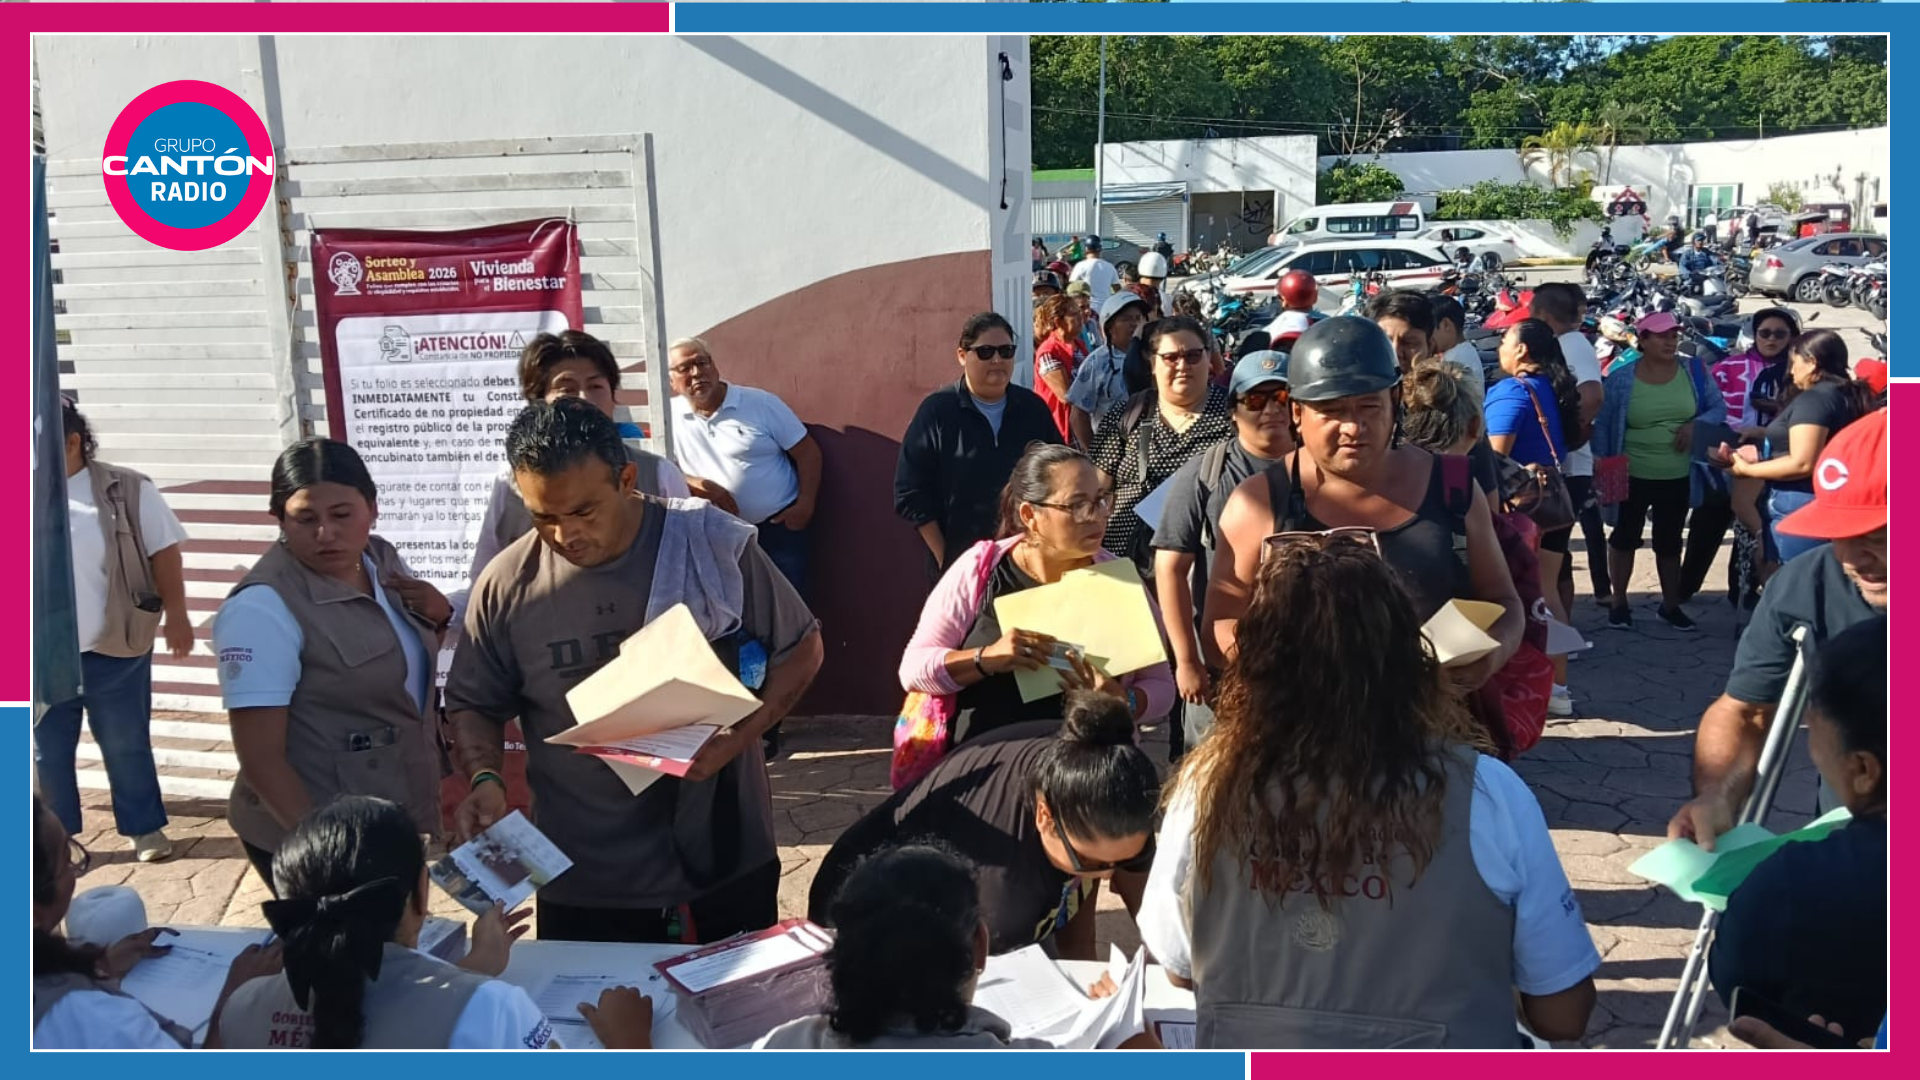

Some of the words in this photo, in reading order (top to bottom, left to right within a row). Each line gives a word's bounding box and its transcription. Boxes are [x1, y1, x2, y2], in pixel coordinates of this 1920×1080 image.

[365, 256, 407, 269] Sorteo
[409, 258, 416, 270] y
[470, 258, 535, 276] Vivienda
[366, 267, 425, 282] Asamblea
[428, 267, 457, 280] 2026
[493, 276, 567, 292] Bienestar
[414, 332, 506, 354] ¡ATENCIÓN!
[419, 352, 458, 361] Constancia
[470, 351, 483, 359] NO
[484, 350, 523, 359] PROPIEDA
[351, 379, 360, 389] Si
[362, 380, 373, 389] tu
[375, 378, 398, 389] folio
[400, 379, 412, 388] es
[414, 376, 480, 388] seleccionado
[483, 375, 515, 386] debes
[352, 391, 451, 404] INMEDIATAMENTE
[463, 393, 475, 402] tu
[487, 391, 525, 401] Consta
[354, 407, 412, 419] Certificado
[415, 408, 428, 418] de
[431, 410, 445, 418] no
[449, 406, 503, 419] propiedad
[356, 423, 364, 433] el
[368, 423, 410, 436] registro
[414, 420, 452, 434] público
[456, 421, 469, 432] de
[473, 421, 483, 431] la
[487, 422, 511, 435] prop
[357, 437, 420, 449] equivalente
[435, 438, 448, 447] en
[451, 438, 474, 446] caso
[478, 436, 491, 446] de
[427, 449, 471, 462] también
[474, 449, 482, 461] el
[485, 450, 498, 461] de
[374, 482, 412, 494] egúrate
[414, 482, 426, 491] de
[429, 482, 461, 491] contar
[464, 482, 481, 491] con
[377, 496, 395, 506] has
[399, 497, 405, 508] y
[409, 496, 446, 509] lugares
[450, 498, 469, 508] que
[377, 511, 420, 521] ormarán
[422, 512, 434, 523] ya
[436, 511, 445, 521] lo
[448, 511, 481, 523] tengas
[396, 539, 447, 552] presentas
[449, 539, 459, 550] la
[410, 556, 427, 566] por
[429, 554, 442, 565] los
[412, 568, 459, 579] ontinuar
[271, 1011, 316, 1026] GOBIE
